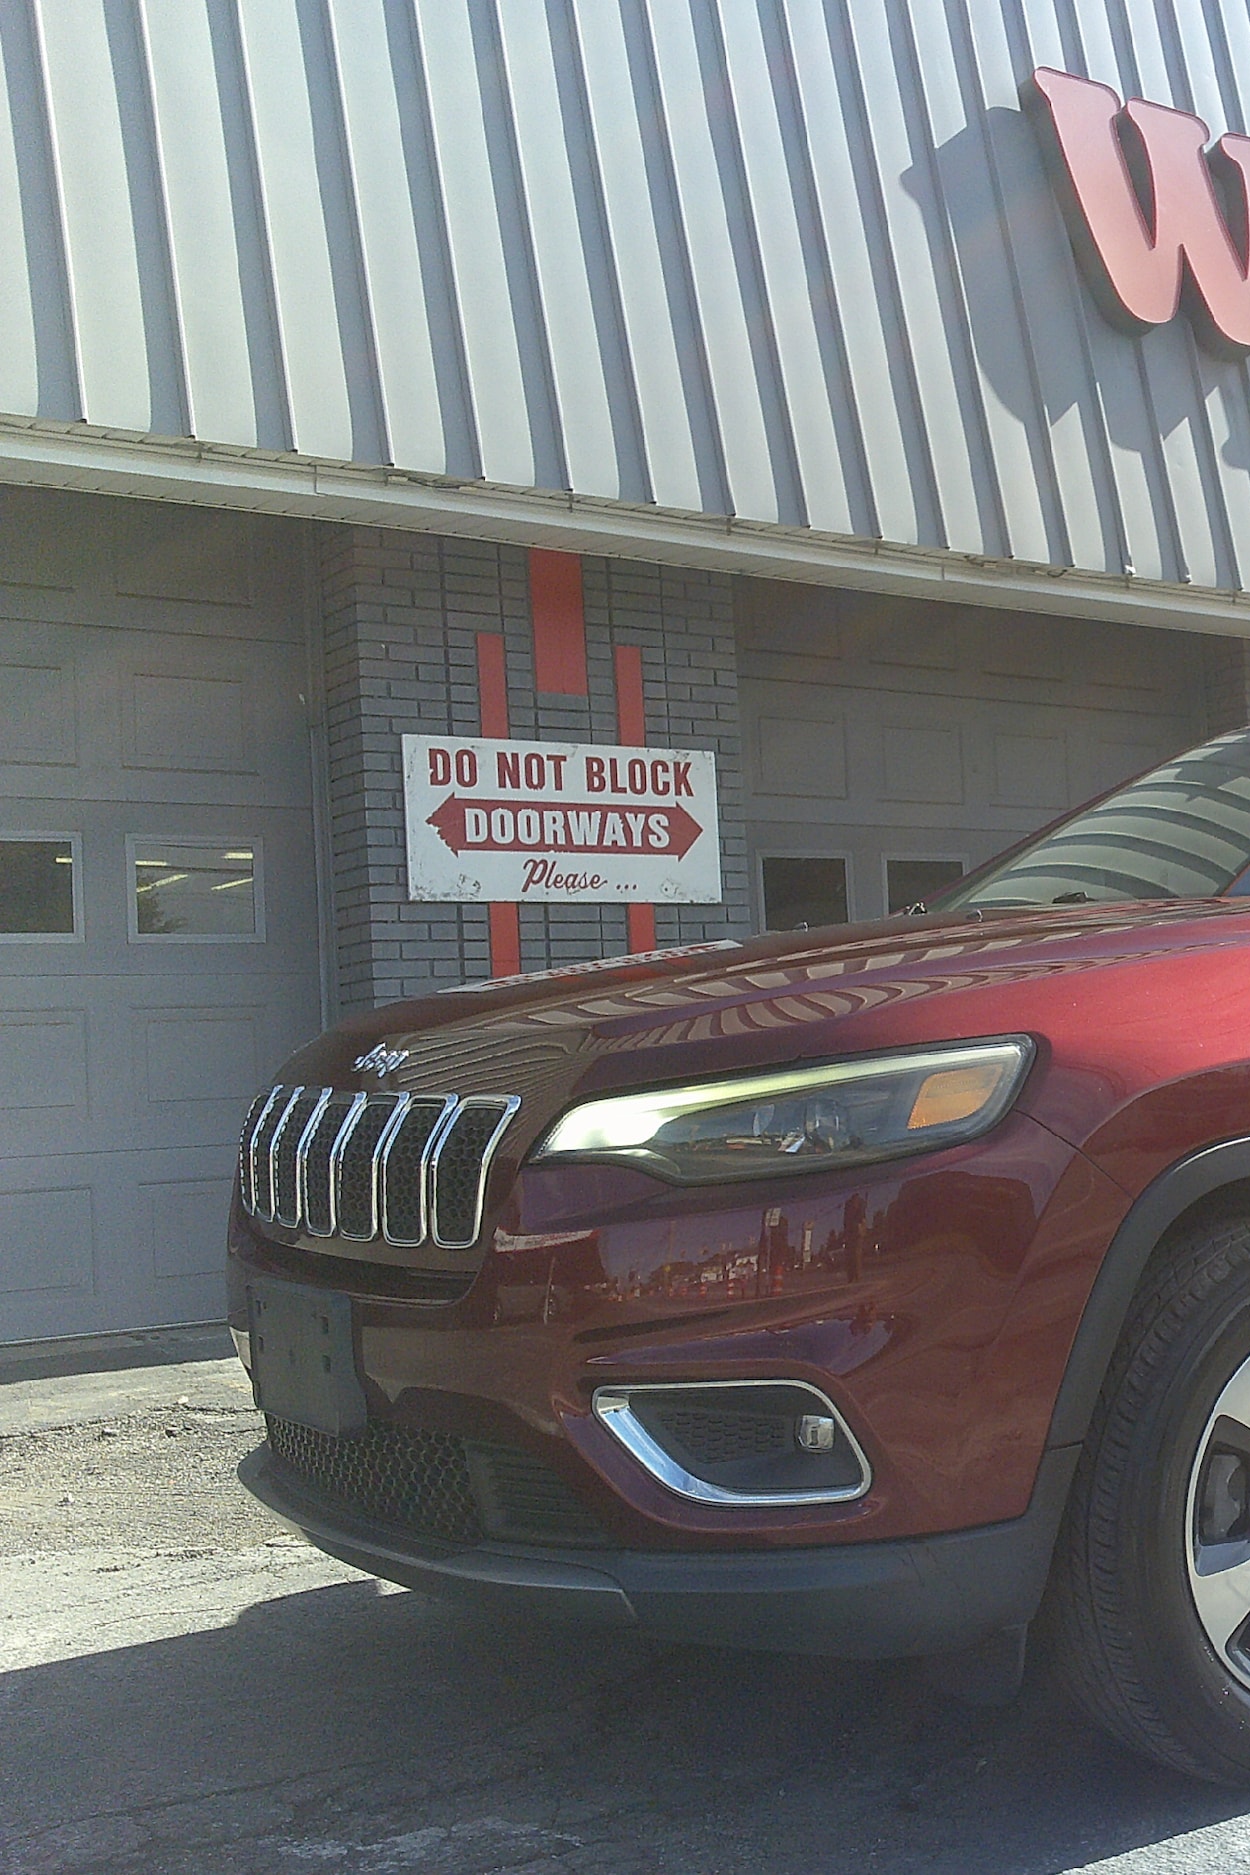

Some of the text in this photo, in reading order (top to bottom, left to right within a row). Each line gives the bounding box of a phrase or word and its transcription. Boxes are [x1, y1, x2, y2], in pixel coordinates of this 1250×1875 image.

[428, 748, 695, 797] DO NOT BLOCK
[464, 807, 670, 849] DOORWAYS
[521, 858, 608, 893] Please
